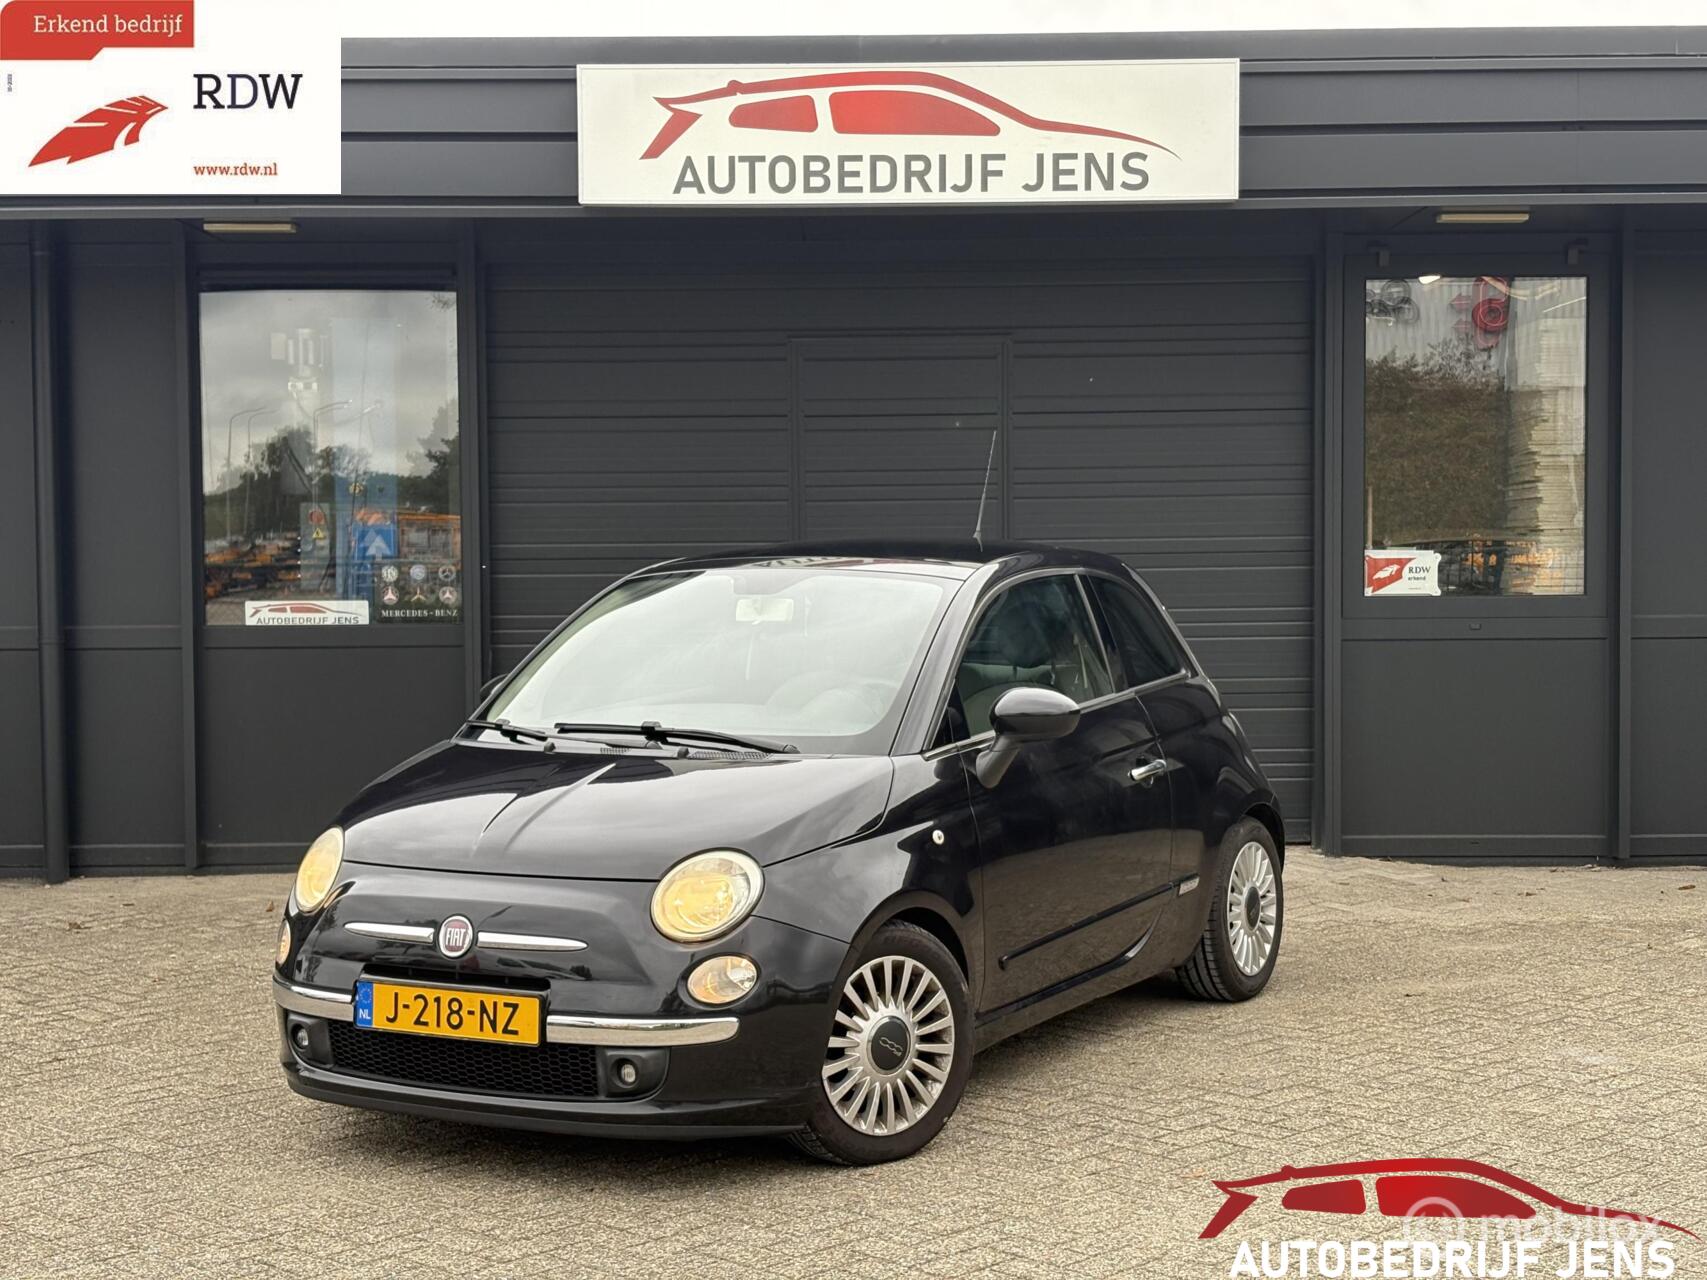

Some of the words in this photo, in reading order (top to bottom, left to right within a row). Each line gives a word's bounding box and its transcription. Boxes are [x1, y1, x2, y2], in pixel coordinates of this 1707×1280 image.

[672, 153, 1007, 195] AUTOBEDRIJF
[1021, 151, 1150, 193] JENS
[1408, 566, 1431, 574] RDW
[256, 616, 328, 625] AUTOBEDRIJF
[332, 616, 360, 625] JENS
[445, 927, 466, 947] FIAT
[359, 1008, 371, 1020] NL
[385, 992, 519, 1036] J-218-NZ
